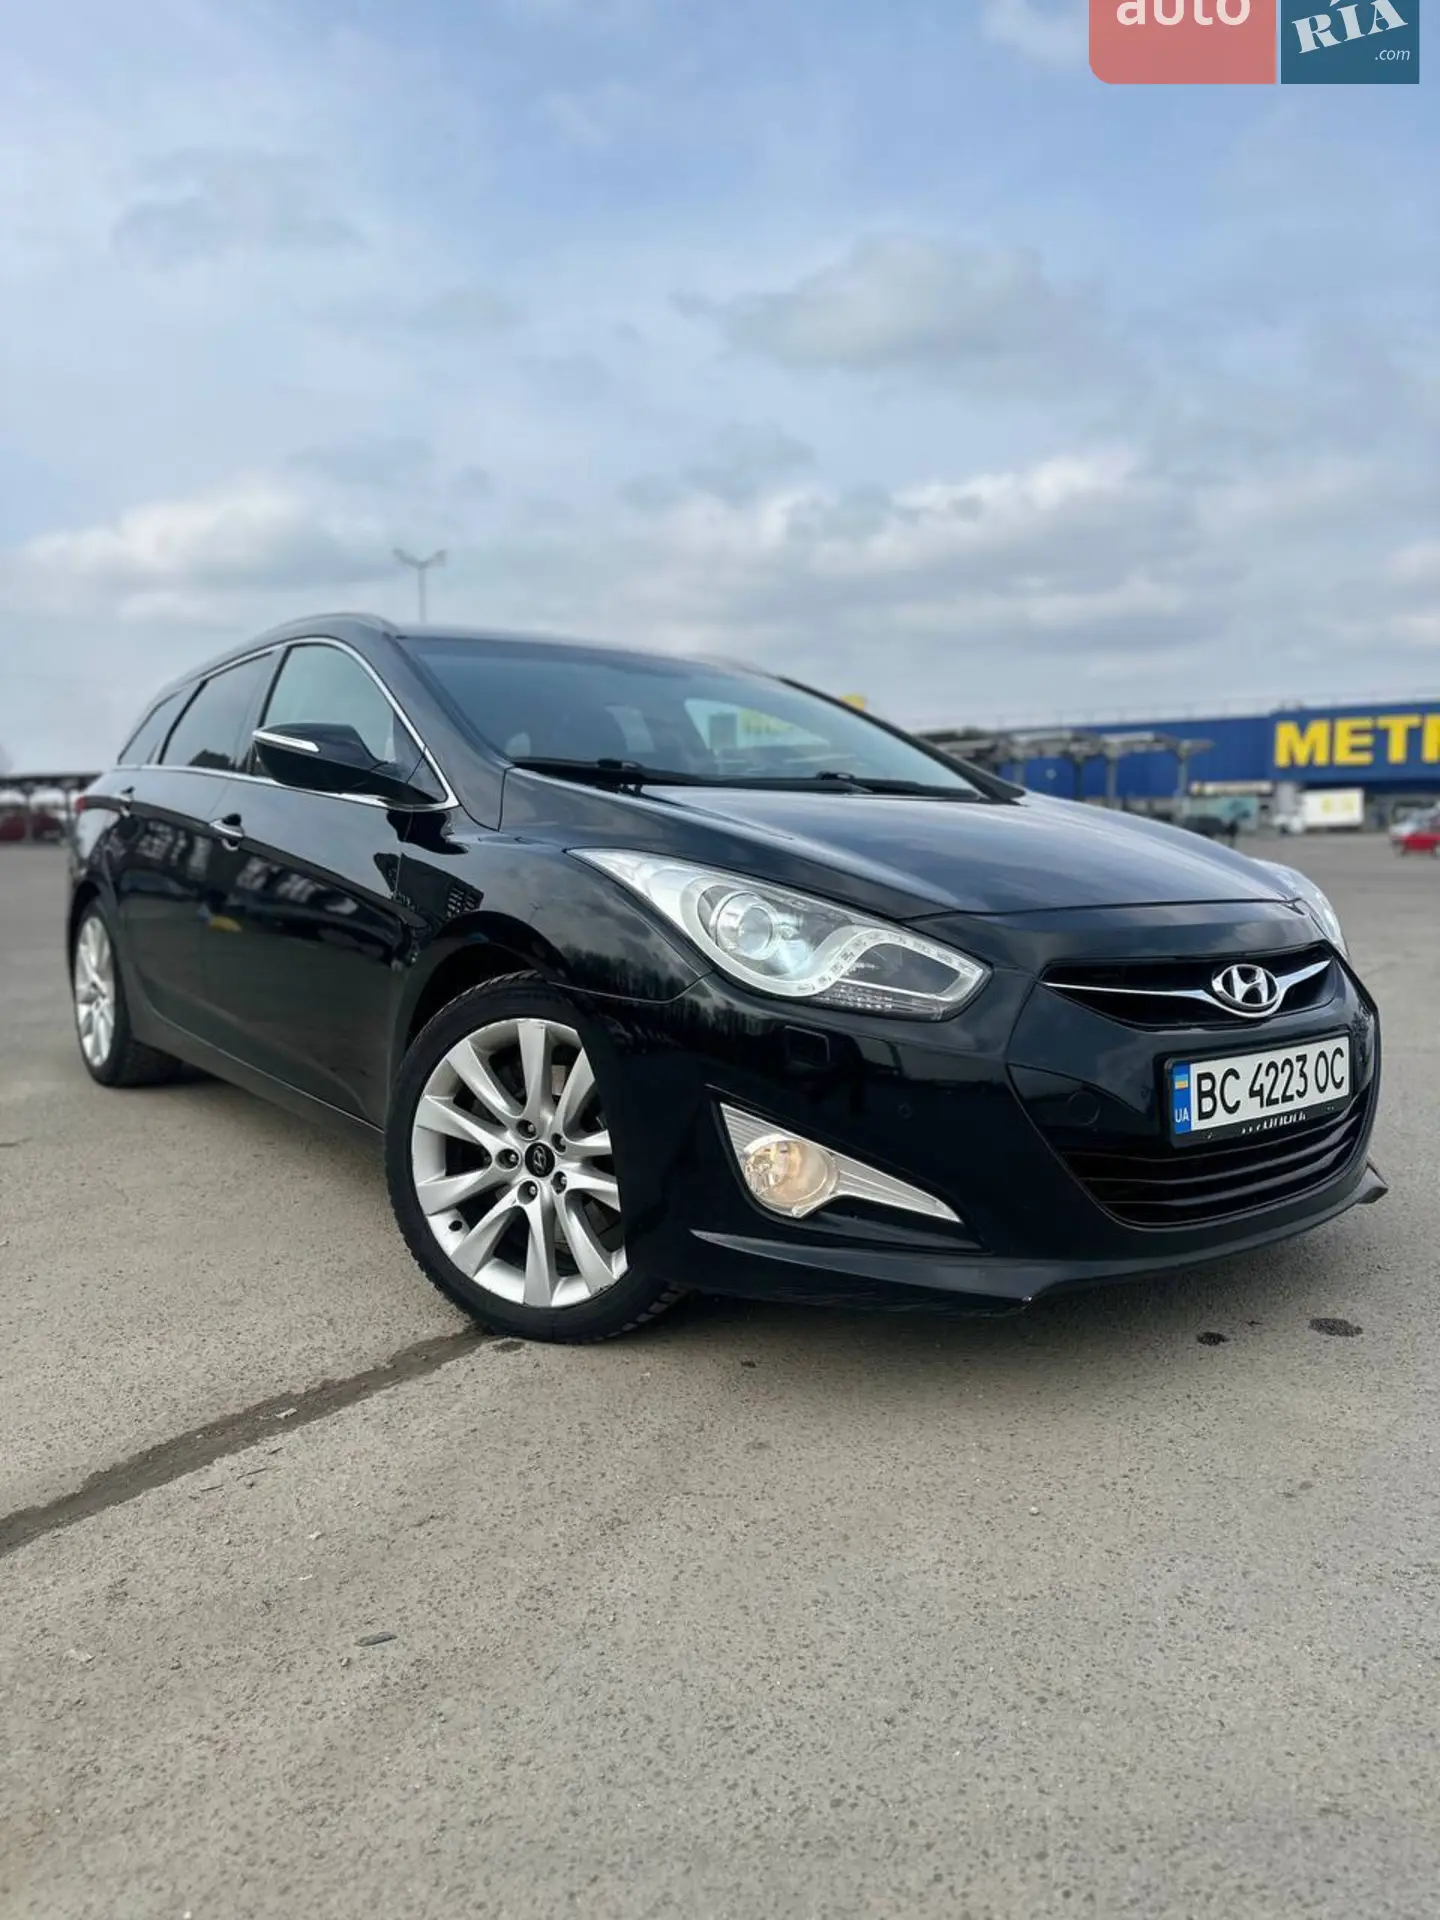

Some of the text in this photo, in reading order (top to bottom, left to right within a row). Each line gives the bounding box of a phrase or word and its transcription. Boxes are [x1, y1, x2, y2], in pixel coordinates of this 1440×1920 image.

[1197, 1067, 1241, 1121] BC
[1248, 1053, 1308, 1109] 4223
[1174, 1107, 1190, 1123] UA
